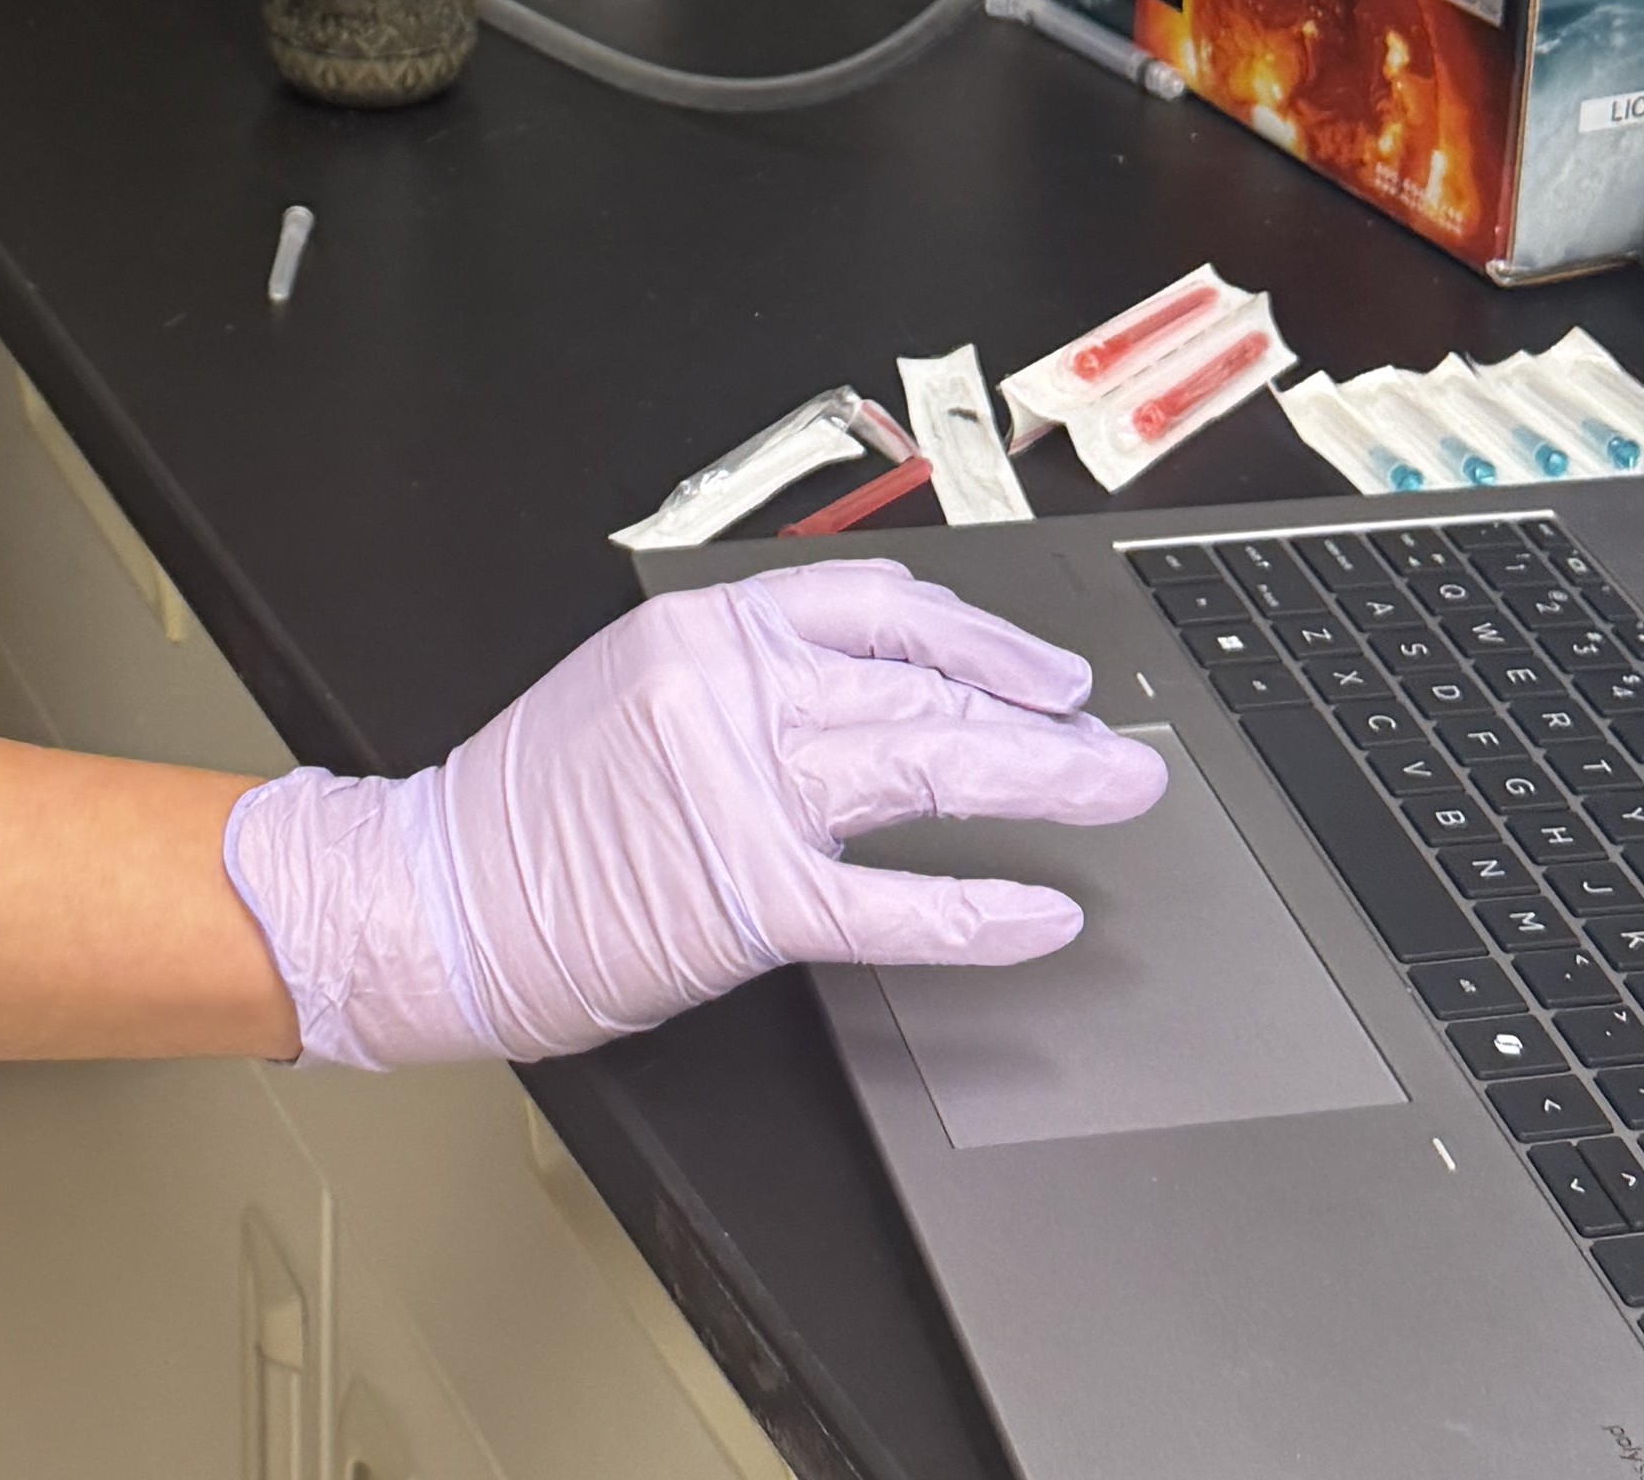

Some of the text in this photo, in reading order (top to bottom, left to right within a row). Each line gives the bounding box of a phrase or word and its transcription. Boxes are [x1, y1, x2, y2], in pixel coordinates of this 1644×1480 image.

[1440, 585, 1465, 598] Q
[1367, 602, 1394, 615] A
[1302, 629, 1331, 642] Z
[1473, 623, 1504, 641] W
[1401, 644, 1427, 655] S
[1333, 671, 1363, 685] X
[1507, 669, 1537, 683] E
[1432, 686, 1460, 699] D
[1369, 716, 1396, 730] C
[1542, 713, 1571, 727] R
[1468, 732, 1499, 744] F
[1404, 762, 1431, 776] V
[1584, 760, 1611, 772] T
[1506, 779, 1534, 794] G
[1436, 811, 1465, 825] B
[1622, 806, 1644, 823] Y
[1541, 827, 1573, 843] H
[1473, 860, 1505, 876] N
[1583, 882, 1612, 892] J
[1510, 912, 1544, 930] M
[1620, 931, 1644, 949] K
